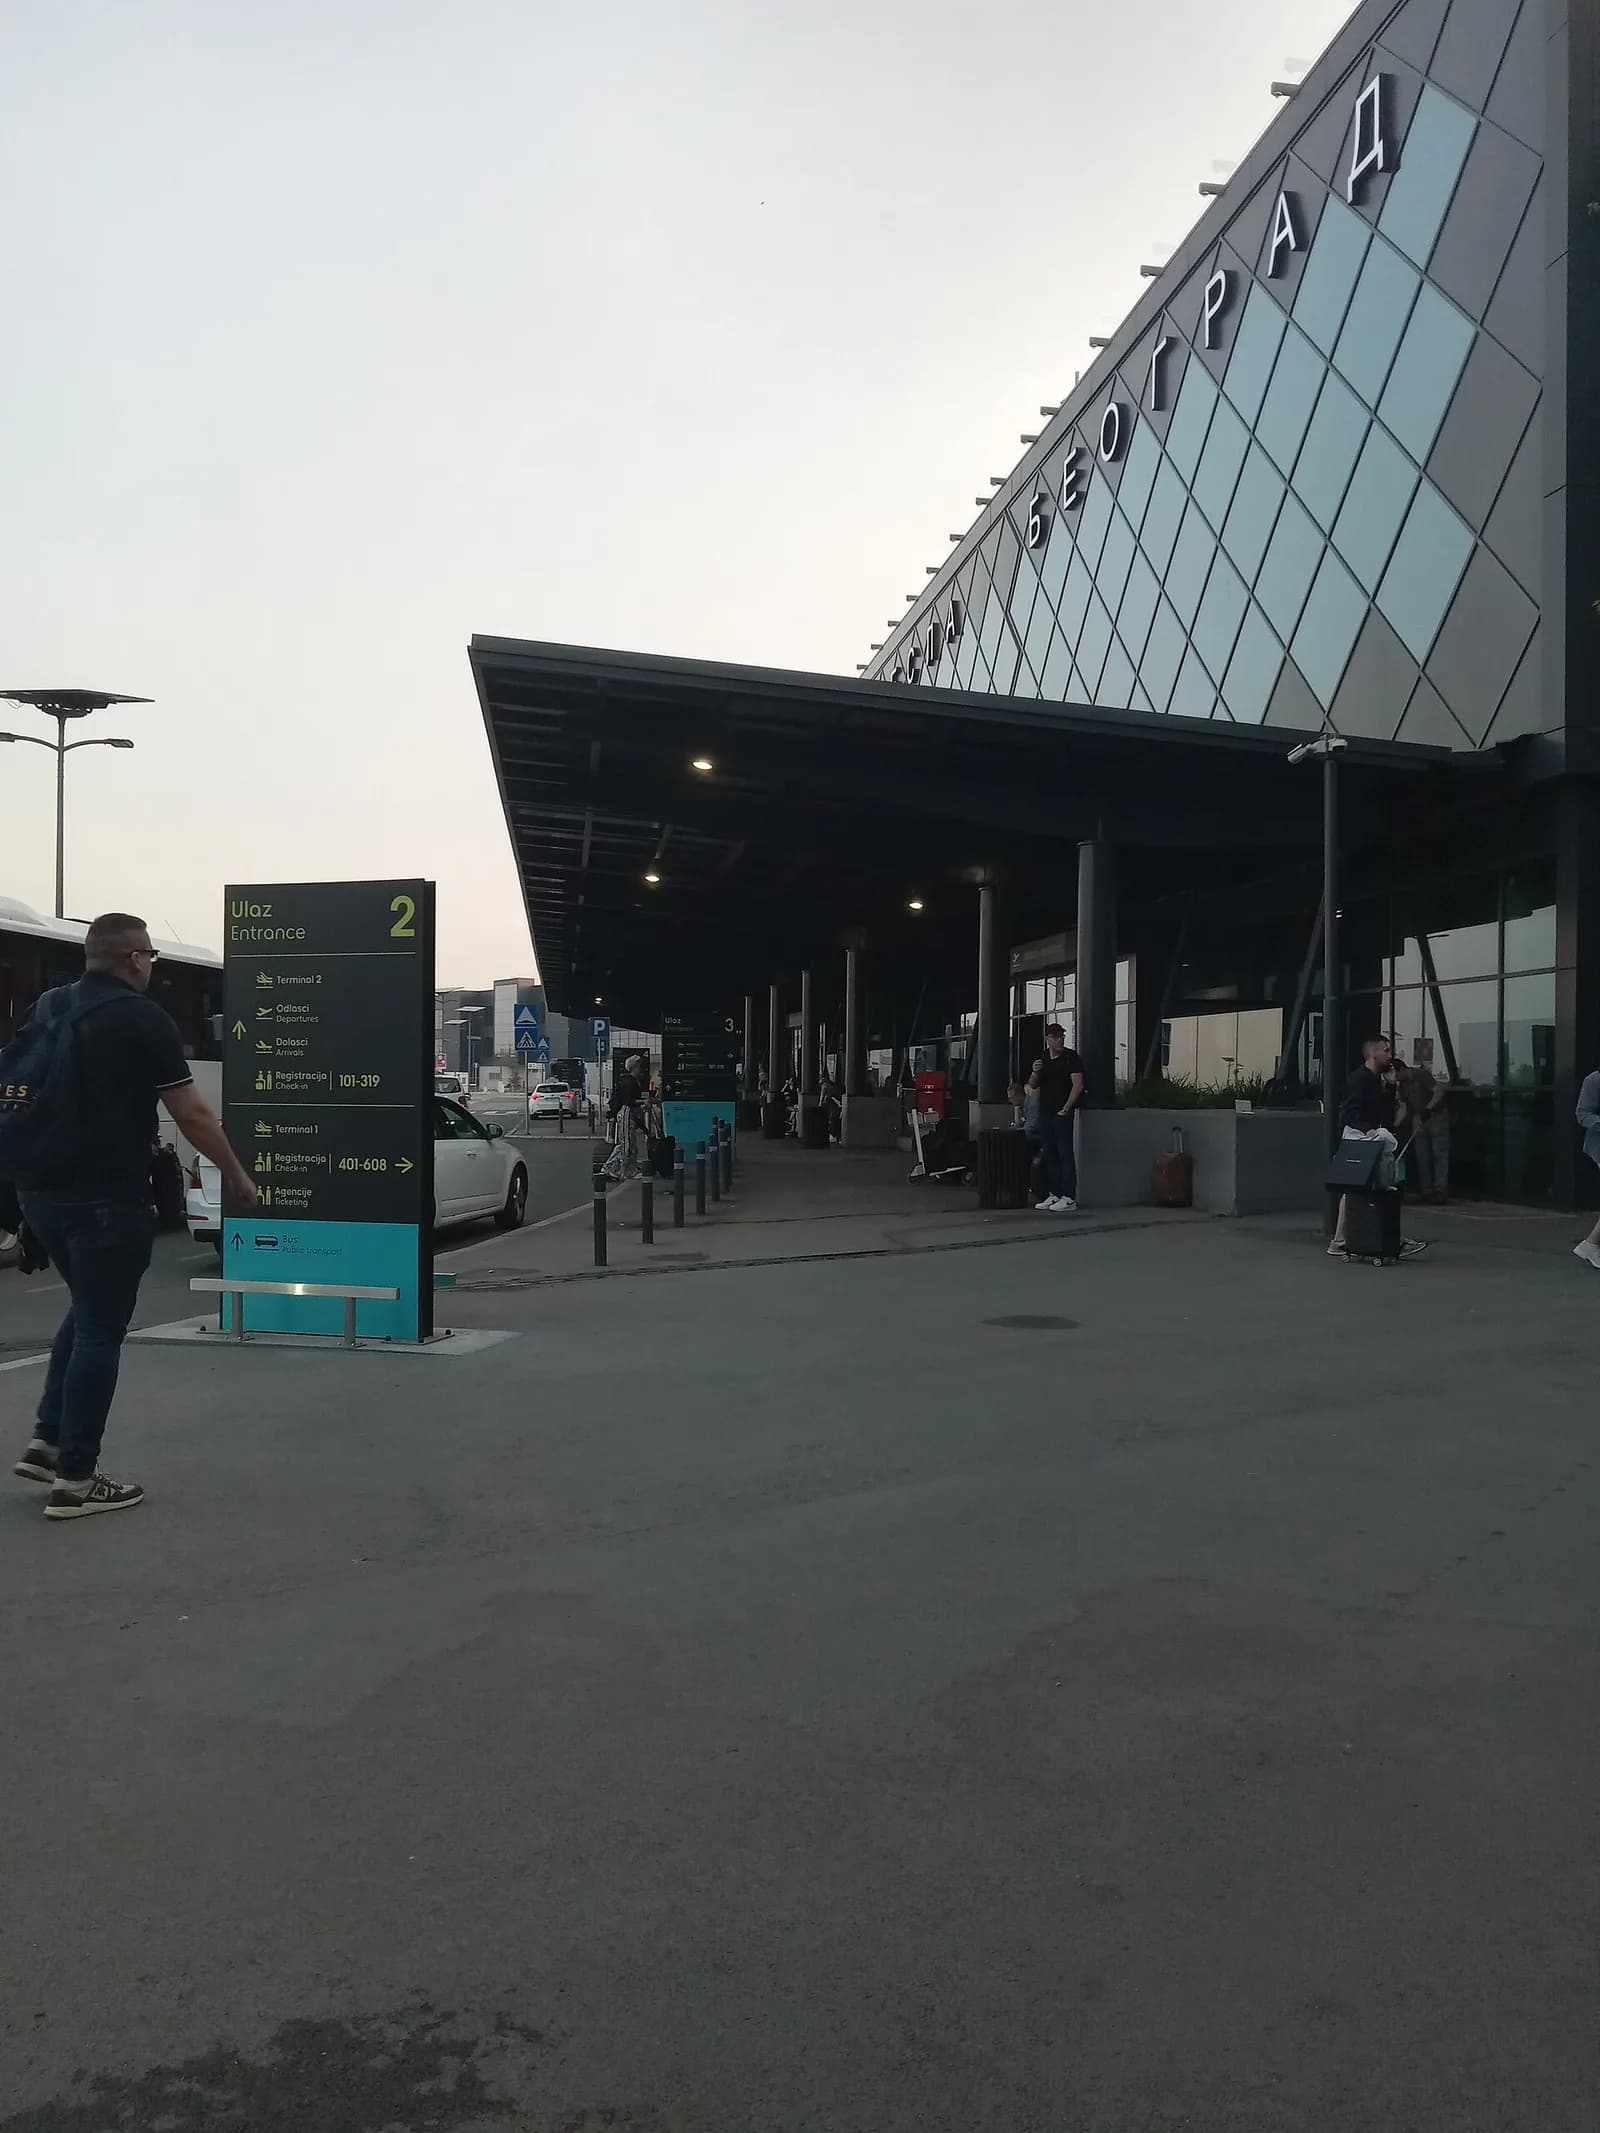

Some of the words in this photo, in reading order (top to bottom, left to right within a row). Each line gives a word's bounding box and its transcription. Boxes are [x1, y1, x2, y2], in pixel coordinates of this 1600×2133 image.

[1028, 72, 1395, 549] БЕОГРАД
[231, 899, 273, 919] Ulaz
[390, 895, 416, 938] 2
[231, 925, 306, 941] Entrance
[277, 974, 315, 985] Terminal
[315, 974, 322, 984] 2
[276, 1003, 310, 1014] Odlasci
[276, 1015, 319, 1025] Departures
[724, 1017, 735, 1033] 3
[593, 1019, 606, 1036] P
[276, 1037, 309, 1047] Dolasci
[276, 1048, 305, 1057] Arrivals
[275, 1071, 328, 1083] Registracija
[339, 1074, 381, 1088] 101-319
[0, 1084, 29, 1097] ES
[275, 1082, 309, 1091] Check-in
[275, 1124, 313, 1135] Terminal
[274, 1153, 327, 1166] Registracija
[338, 1157, 388, 1172] 401-608
[274, 1164, 308, 1173] Check-in
[274, 1186, 313, 1199] Agencije
[274, 1197, 309, 1208] Ticketing
[282, 1234, 298, 1244] Bus
